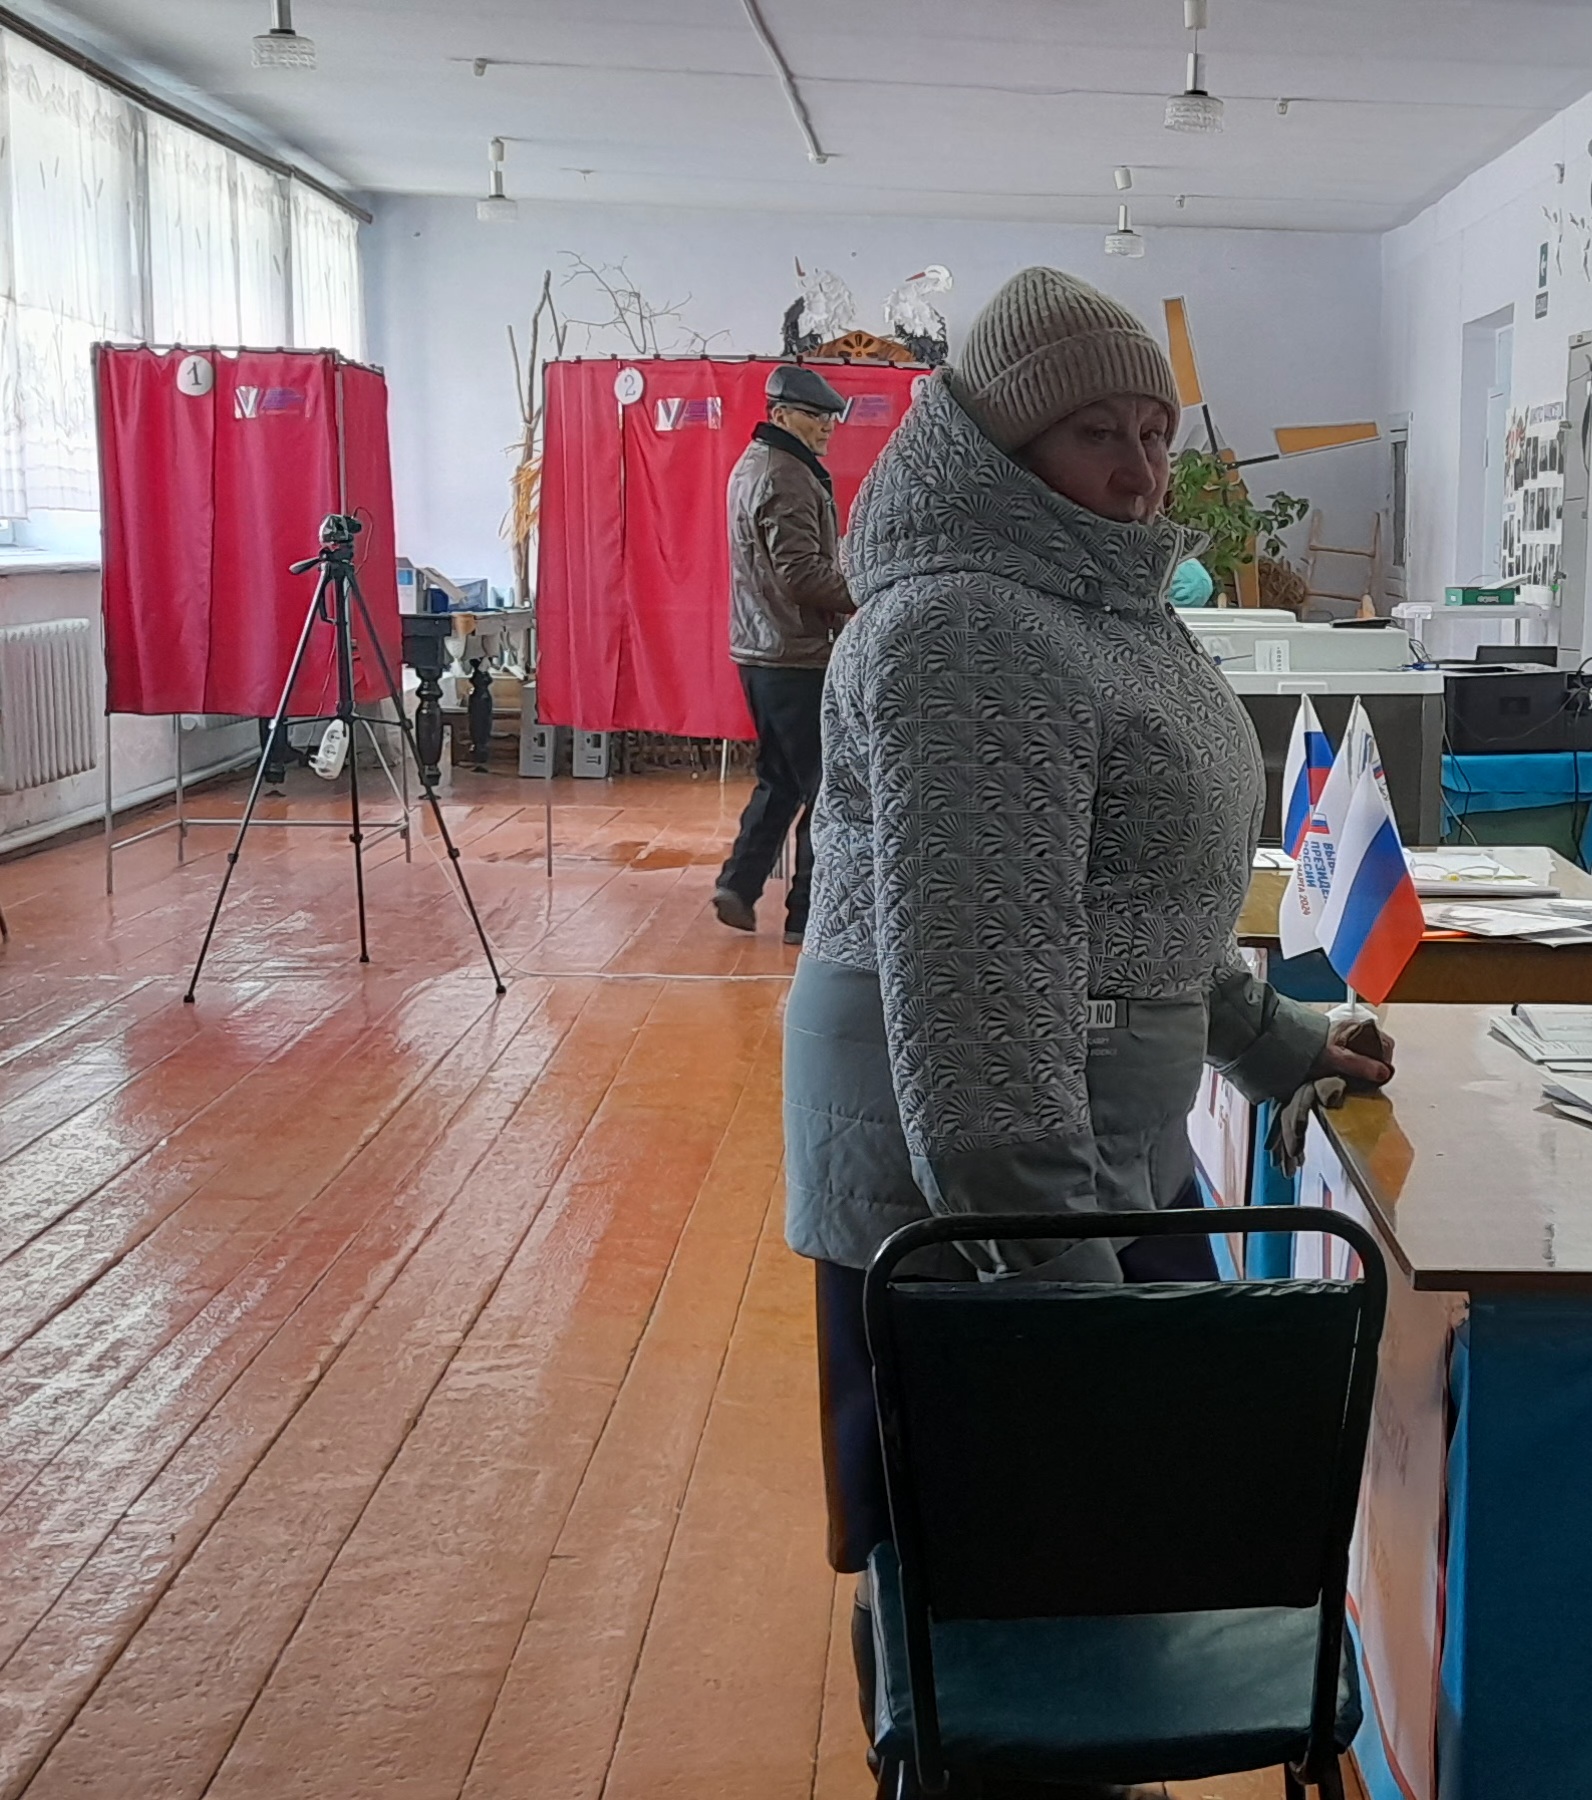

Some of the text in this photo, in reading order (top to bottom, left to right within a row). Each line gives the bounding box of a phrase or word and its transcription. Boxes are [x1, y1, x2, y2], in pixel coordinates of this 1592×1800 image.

[186, 361, 202, 386] 1
[623, 374, 637, 397] 2
[1323, 842, 1335, 874] ВЫБ
